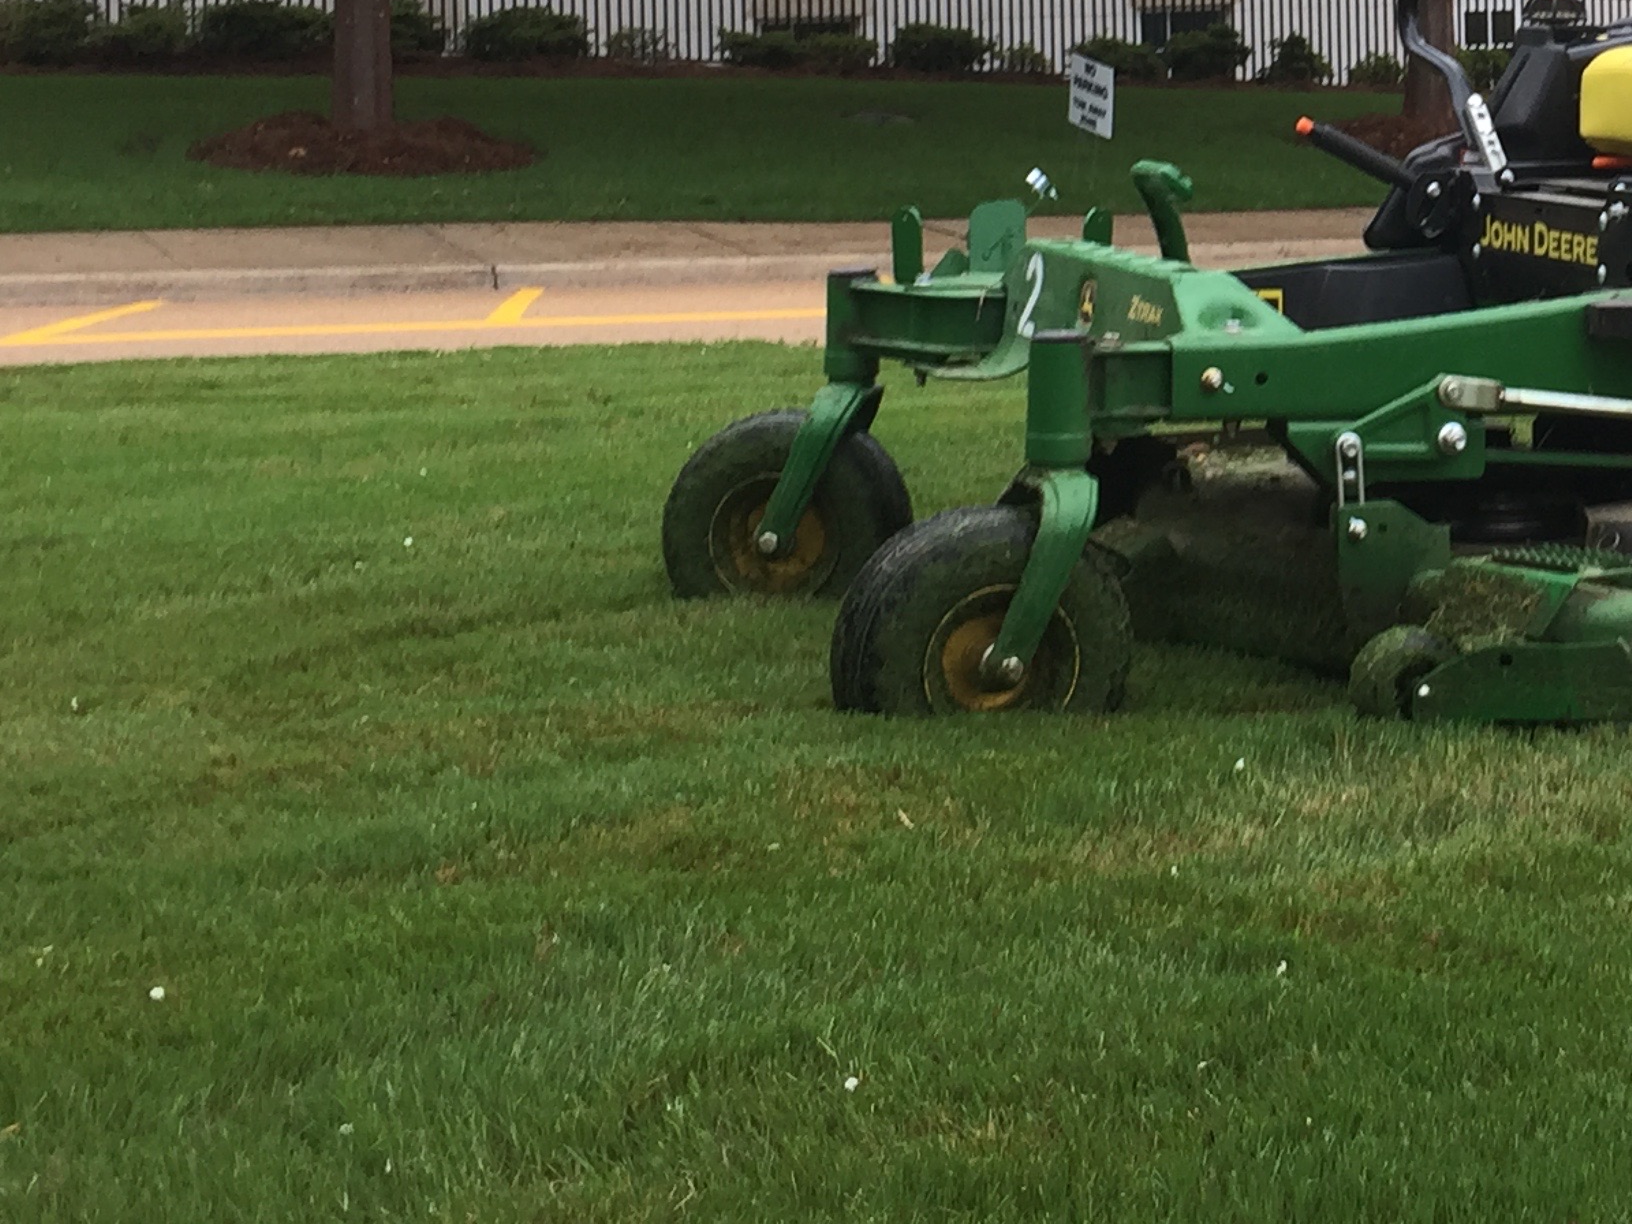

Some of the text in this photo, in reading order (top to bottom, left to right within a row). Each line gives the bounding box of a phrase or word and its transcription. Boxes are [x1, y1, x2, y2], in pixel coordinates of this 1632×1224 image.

[1073, 74, 1108, 101] PARKING
[1085, 63, 1096, 77] NO
[1480, 213, 1599, 267] JOHN DEERE
[1017, 251, 1044, 338] 2
